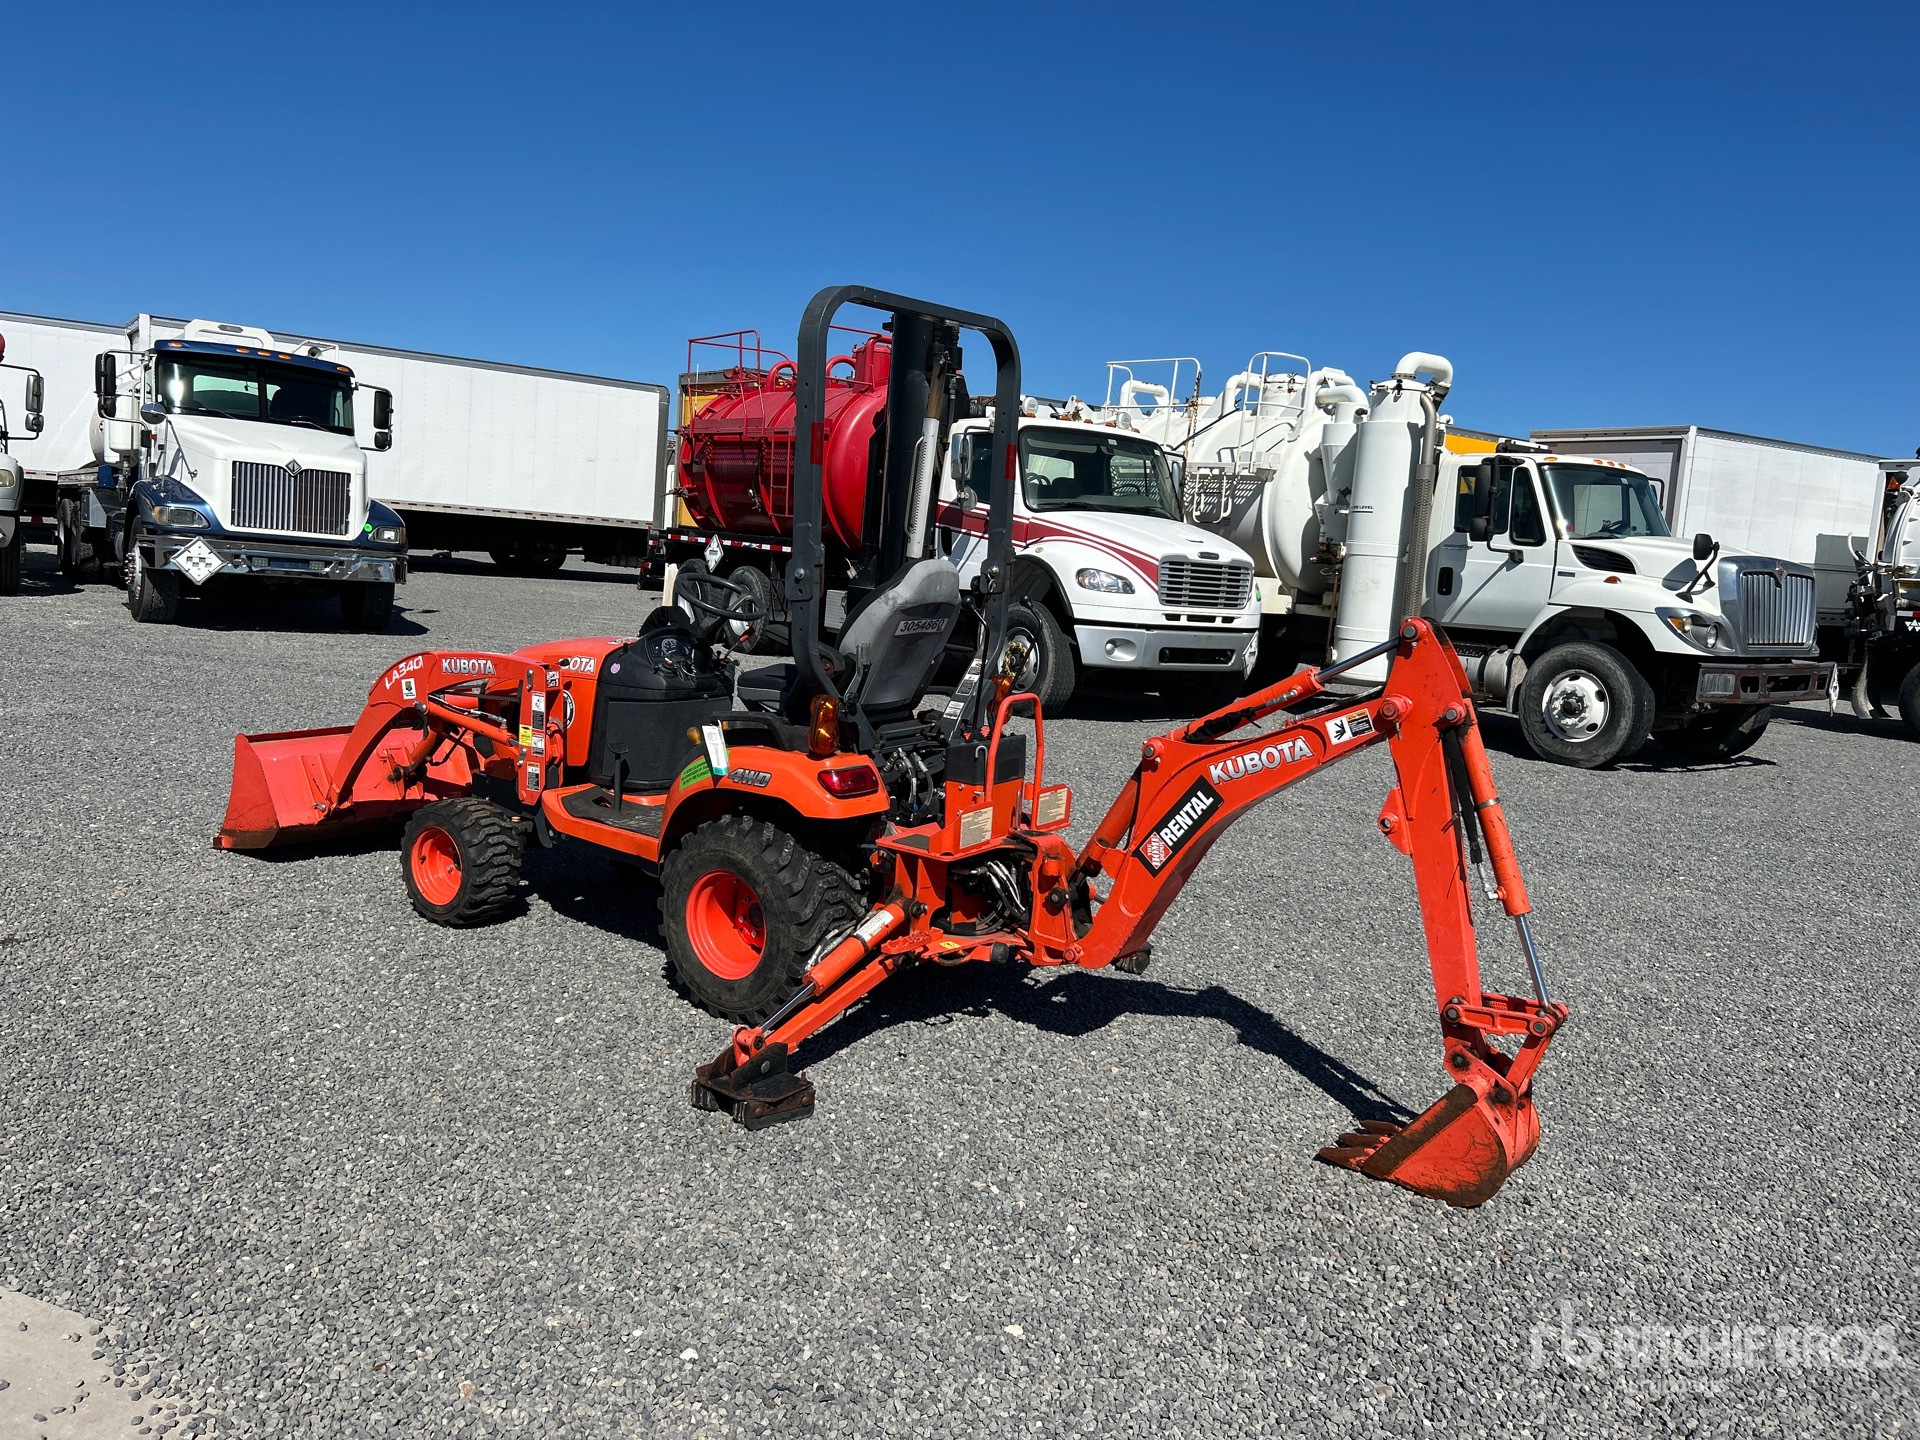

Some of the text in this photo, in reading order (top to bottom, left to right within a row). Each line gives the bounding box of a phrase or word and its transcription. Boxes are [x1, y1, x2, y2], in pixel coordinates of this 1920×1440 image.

[901, 619, 945, 632] 3054860
[385, 656, 424, 690] LA340
[442, 659, 495, 675] KUBOTA
[1208, 737, 1314, 785] KUBOTA
[728, 768, 772, 788] 4WD
[1160, 790, 1214, 847] RENTAL
[1151, 838, 1160, 865] HOME
